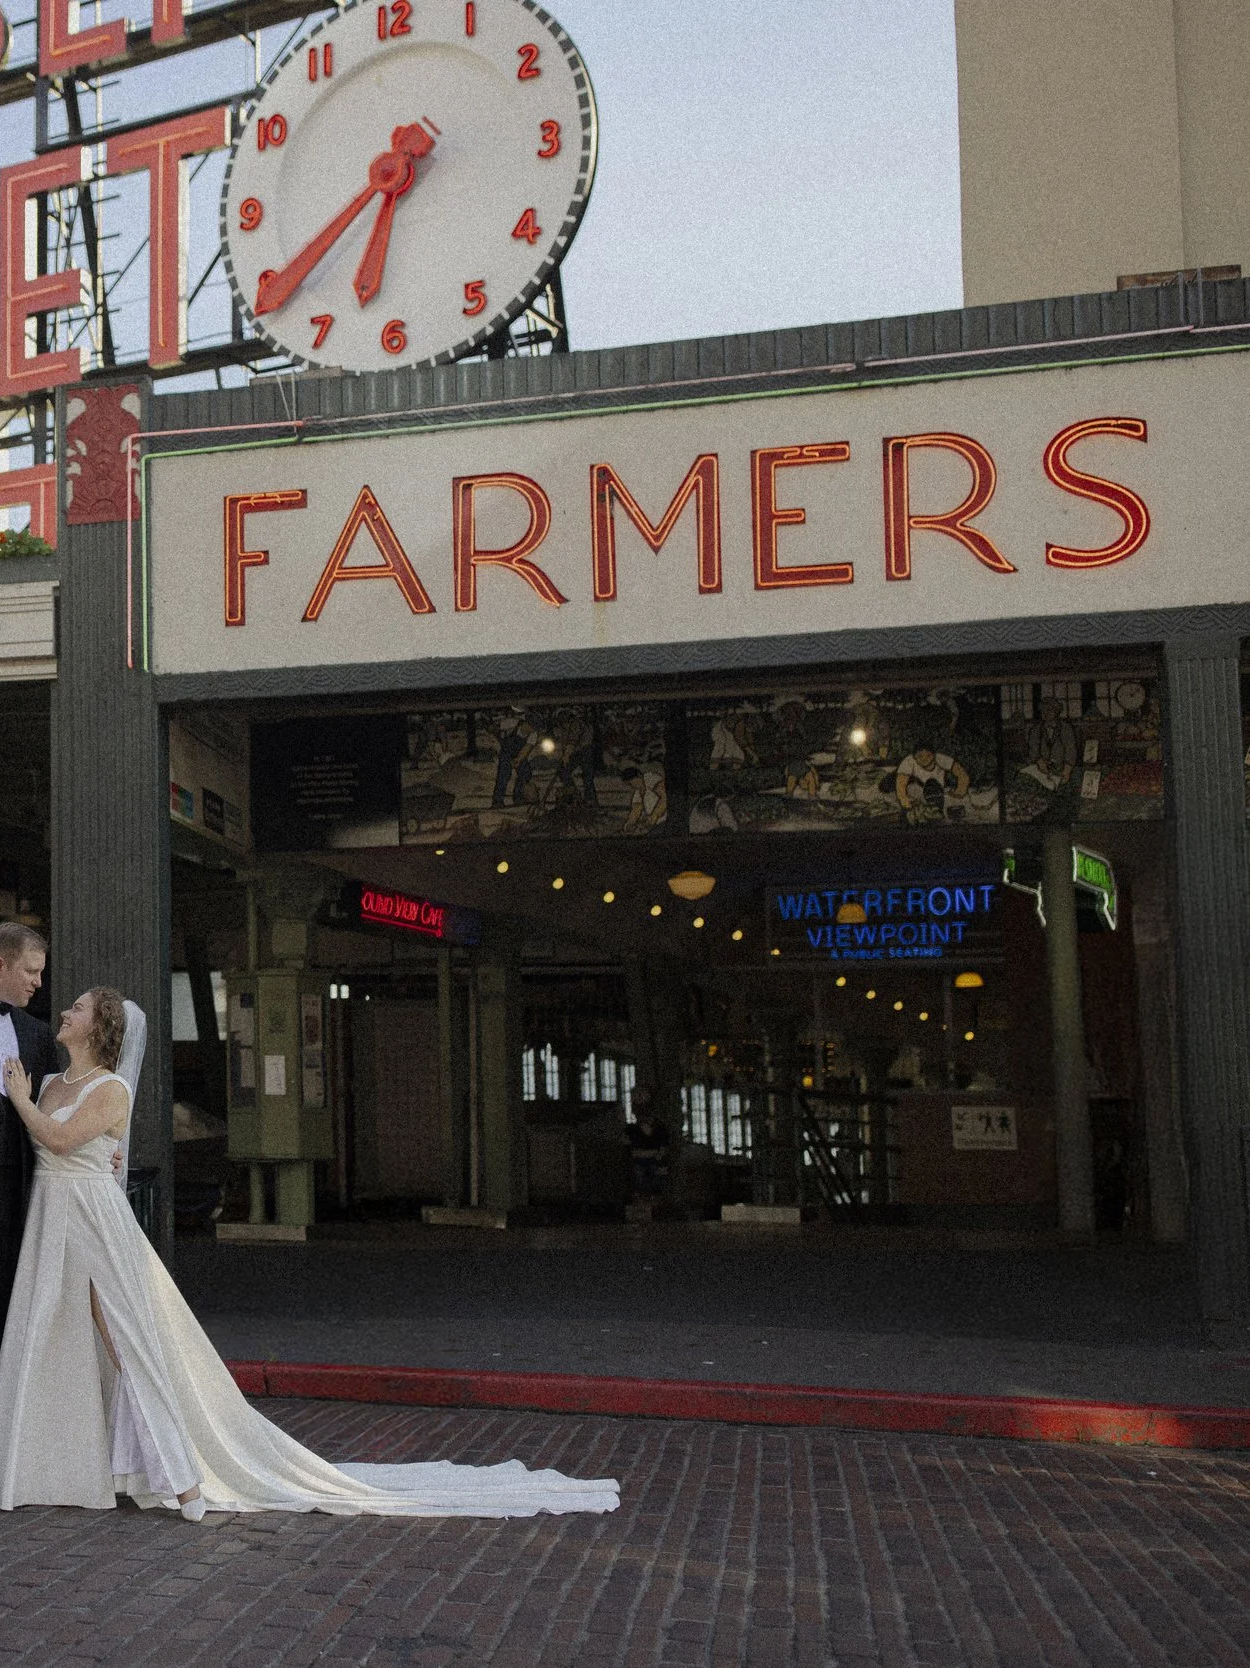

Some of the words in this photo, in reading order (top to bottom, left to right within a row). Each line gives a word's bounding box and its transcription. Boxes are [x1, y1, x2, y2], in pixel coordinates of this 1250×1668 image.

[377, 0, 411, 40] 12
[465, 1, 474, 36] 1
[308, 43, 333, 82] 11
[517, 43, 542, 80] 2
[257, 114, 288, 151] 10
[537, 120, 561, 158] 3
[239, 197, 264, 231] 9
[511, 207, 542, 245] 4
[463, 280, 488, 316] 5
[310, 314, 335, 349] 7
[381, 320, 407, 355] 6
[223, 416, 1151, 627] FARMERS
[361, 892, 393, 916] OUND
[806, 921, 968, 948] VIEWPOINT
[889, 947, 944, 958] SEATING
